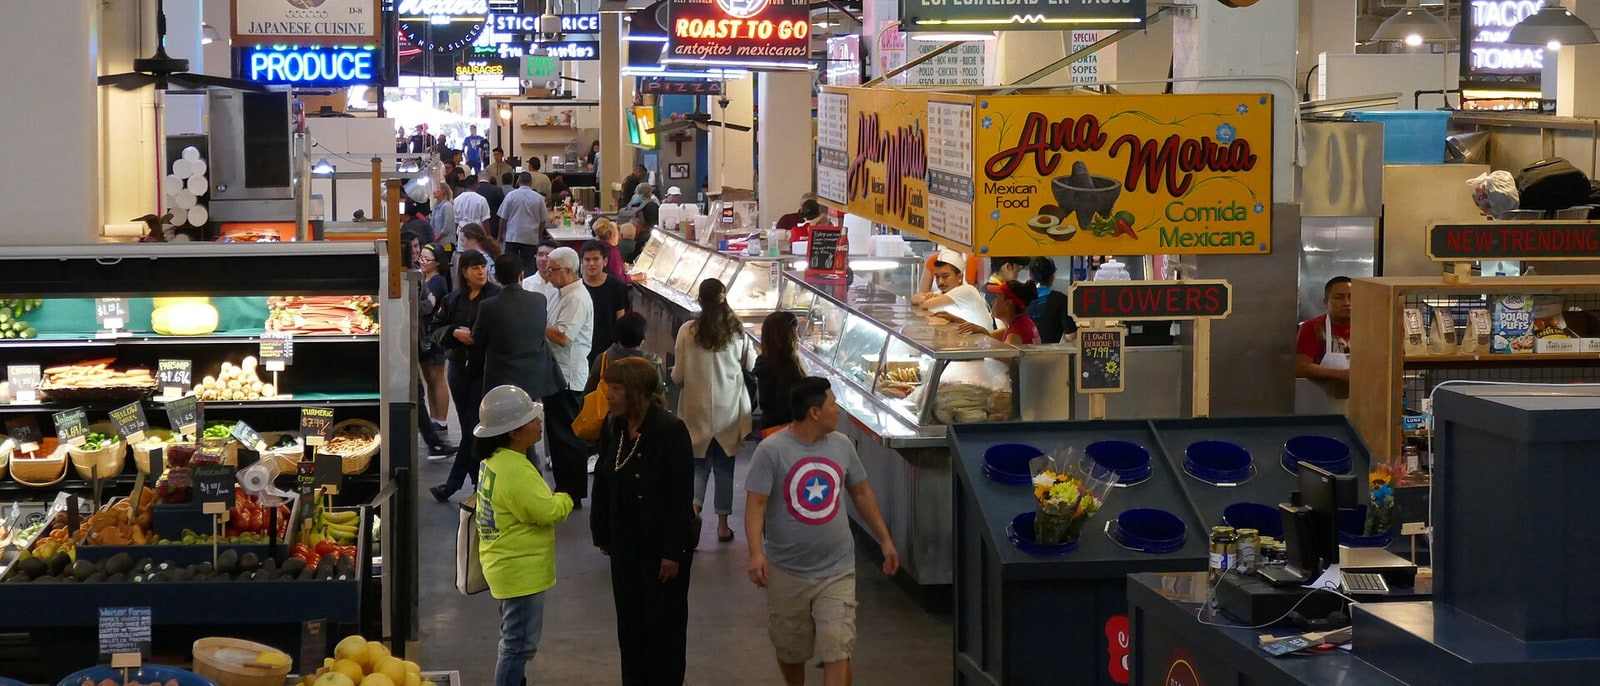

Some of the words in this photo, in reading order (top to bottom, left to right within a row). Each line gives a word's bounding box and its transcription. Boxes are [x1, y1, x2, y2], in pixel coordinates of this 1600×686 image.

[248, 22, 312, 34] JAPANESE
[314, 22, 366, 34] CUISINE
[562, 17, 598, 30] RICE
[676, 18, 742, 38] ROAST
[746, 20, 773, 39] TO
[778, 20, 808, 39] GO
[401, 23, 434, 50] HAND
[448, 24, 480, 51] SLICED
[736, 43, 807, 56] mexicanos
[251, 53, 372, 81] PRODUCE
[456, 65, 504, 75] SAUSAGES
[527, 56, 552, 77] EXIT
[919, 67, 934, 76] POLLO
[938, 67, 958, 76] CHICKEN
[962, 67, 977, 76] POLLO
[1072, 65, 1097, 74] SOPES
[646, 82, 721, 92] PIZZA
[984, 112, 1108, 181] Ana
[1109, 133, 1257, 197] Maria
[849, 110, 881, 202] Ana
[881, 126, 927, 221] Maria
[984, 182, 1037, 195] Mexican
[996, 196, 1029, 208] Food
[1165, 200, 1247, 223] Comida
[1159, 227, 1255, 249] Mexicana
[1447, 229, 1599, 251] NEW-TRENDING
[1082, 288, 1221, 313] FLOWERS
[1500, 313, 1529, 322] POLAR
[1500, 321, 1529, 330] PUFFS
[1083, 333, 1114, 341] FLOWER
[1084, 340, 1121, 348] BOUQUETS
[1086, 347, 1109, 358] $7.99
[159, 361, 189, 371] PARSNIP
[111, 403, 138, 420] YELLOW
[302, 408, 334, 417] TURMERIC
